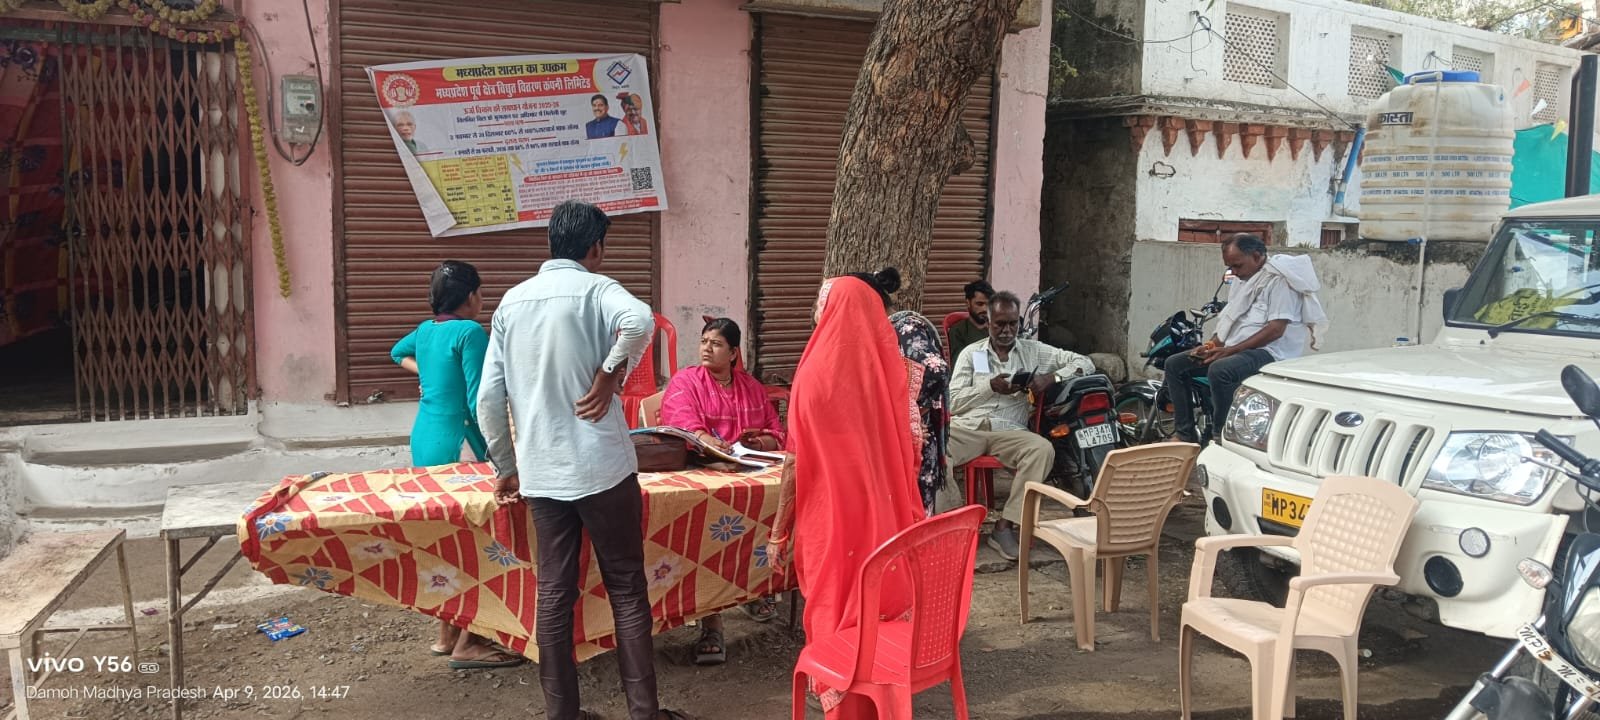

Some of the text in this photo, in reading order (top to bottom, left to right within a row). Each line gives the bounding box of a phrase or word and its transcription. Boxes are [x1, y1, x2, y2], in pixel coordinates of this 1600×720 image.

[456, 63, 567, 78] मध्यप्रदेश शासन का उपक्रम
[435, 84, 468, 98] मध्यप्रदेश
[469, 82, 481, 100] पूर्व
[483, 81, 496, 96] क्षेत्र
[517, 79, 541, 93] वितरण
[543, 77, 563, 90] कंपनी
[563, 75, 591, 89] लिमिटेड
